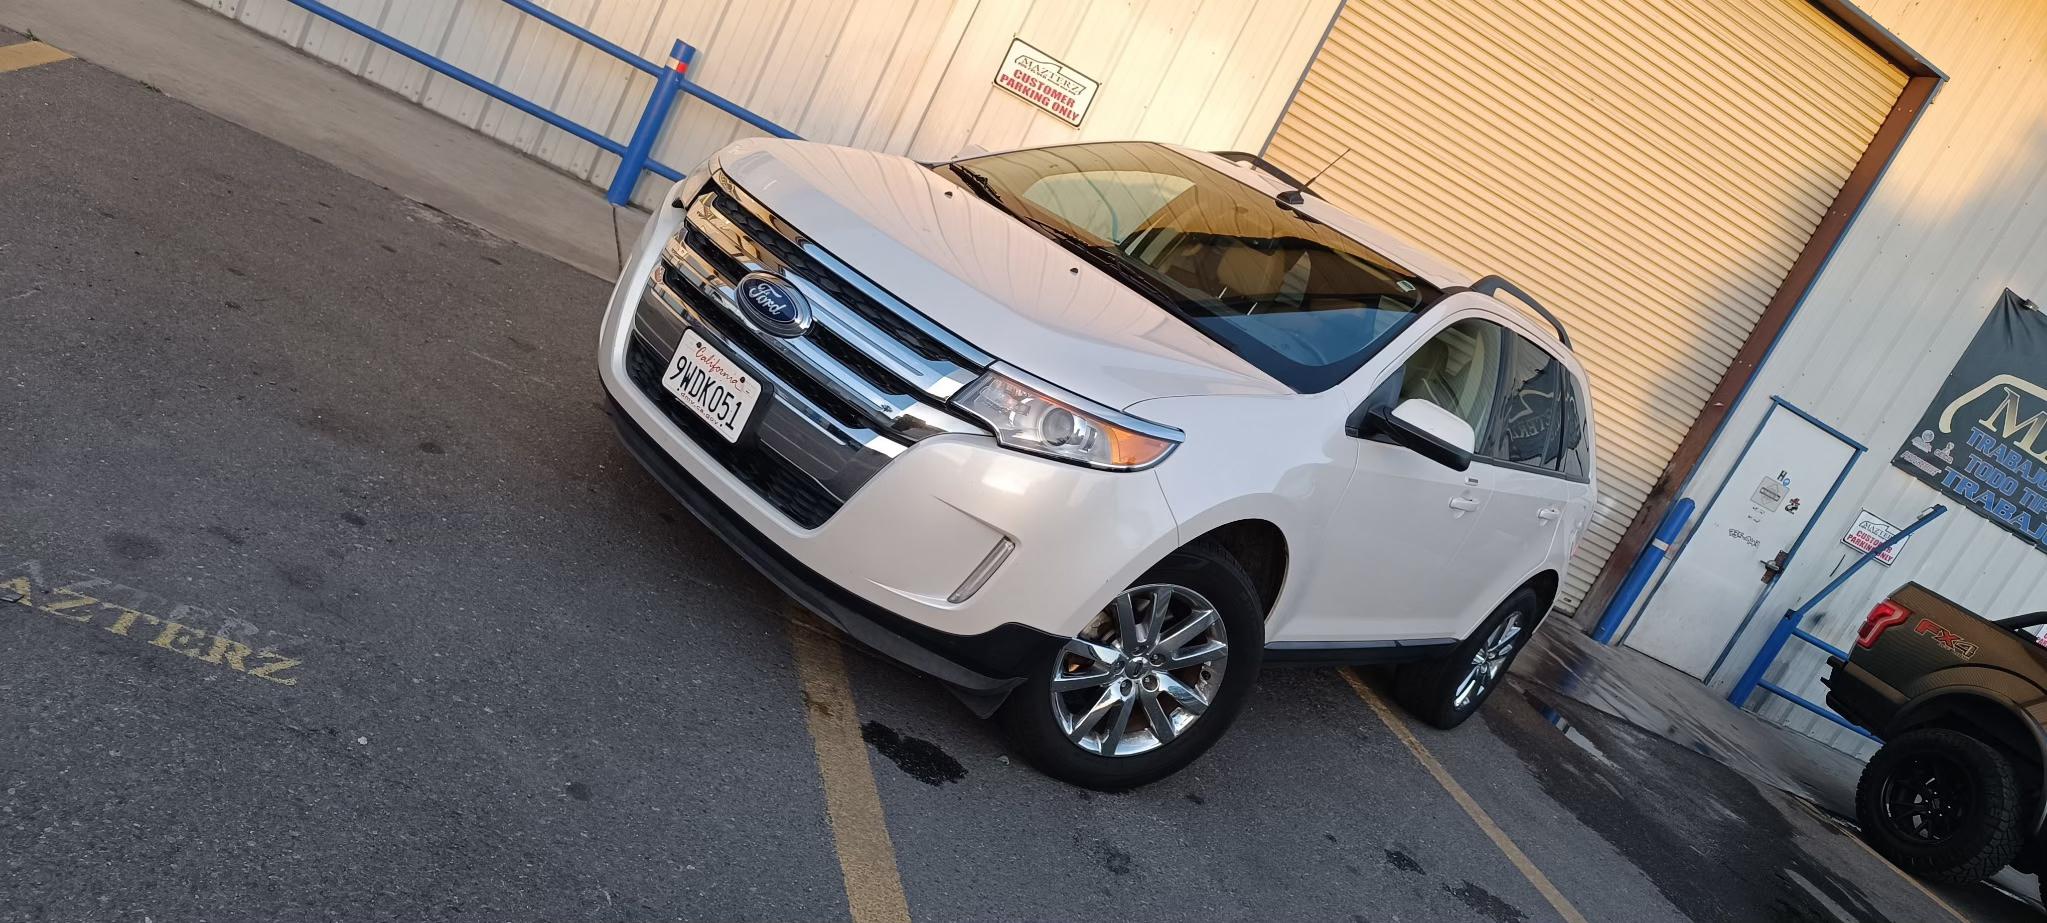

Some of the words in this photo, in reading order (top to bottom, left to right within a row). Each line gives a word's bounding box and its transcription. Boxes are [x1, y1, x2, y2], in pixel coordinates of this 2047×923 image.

[1013, 69, 1076, 108] CUSTOMER
[1020, 57, 1081, 93] MAZTERZ
[1000, 73, 1051, 106] PARKING
[1051, 101, 1080, 121] ONLY
[749, 282, 787, 316] Ford
[695, 346, 743, 393] California
[669, 355, 743, 431] 9WDK051
[1964, 453, 2019, 497] TODO
[1914, 618, 1980, 660] FX4
